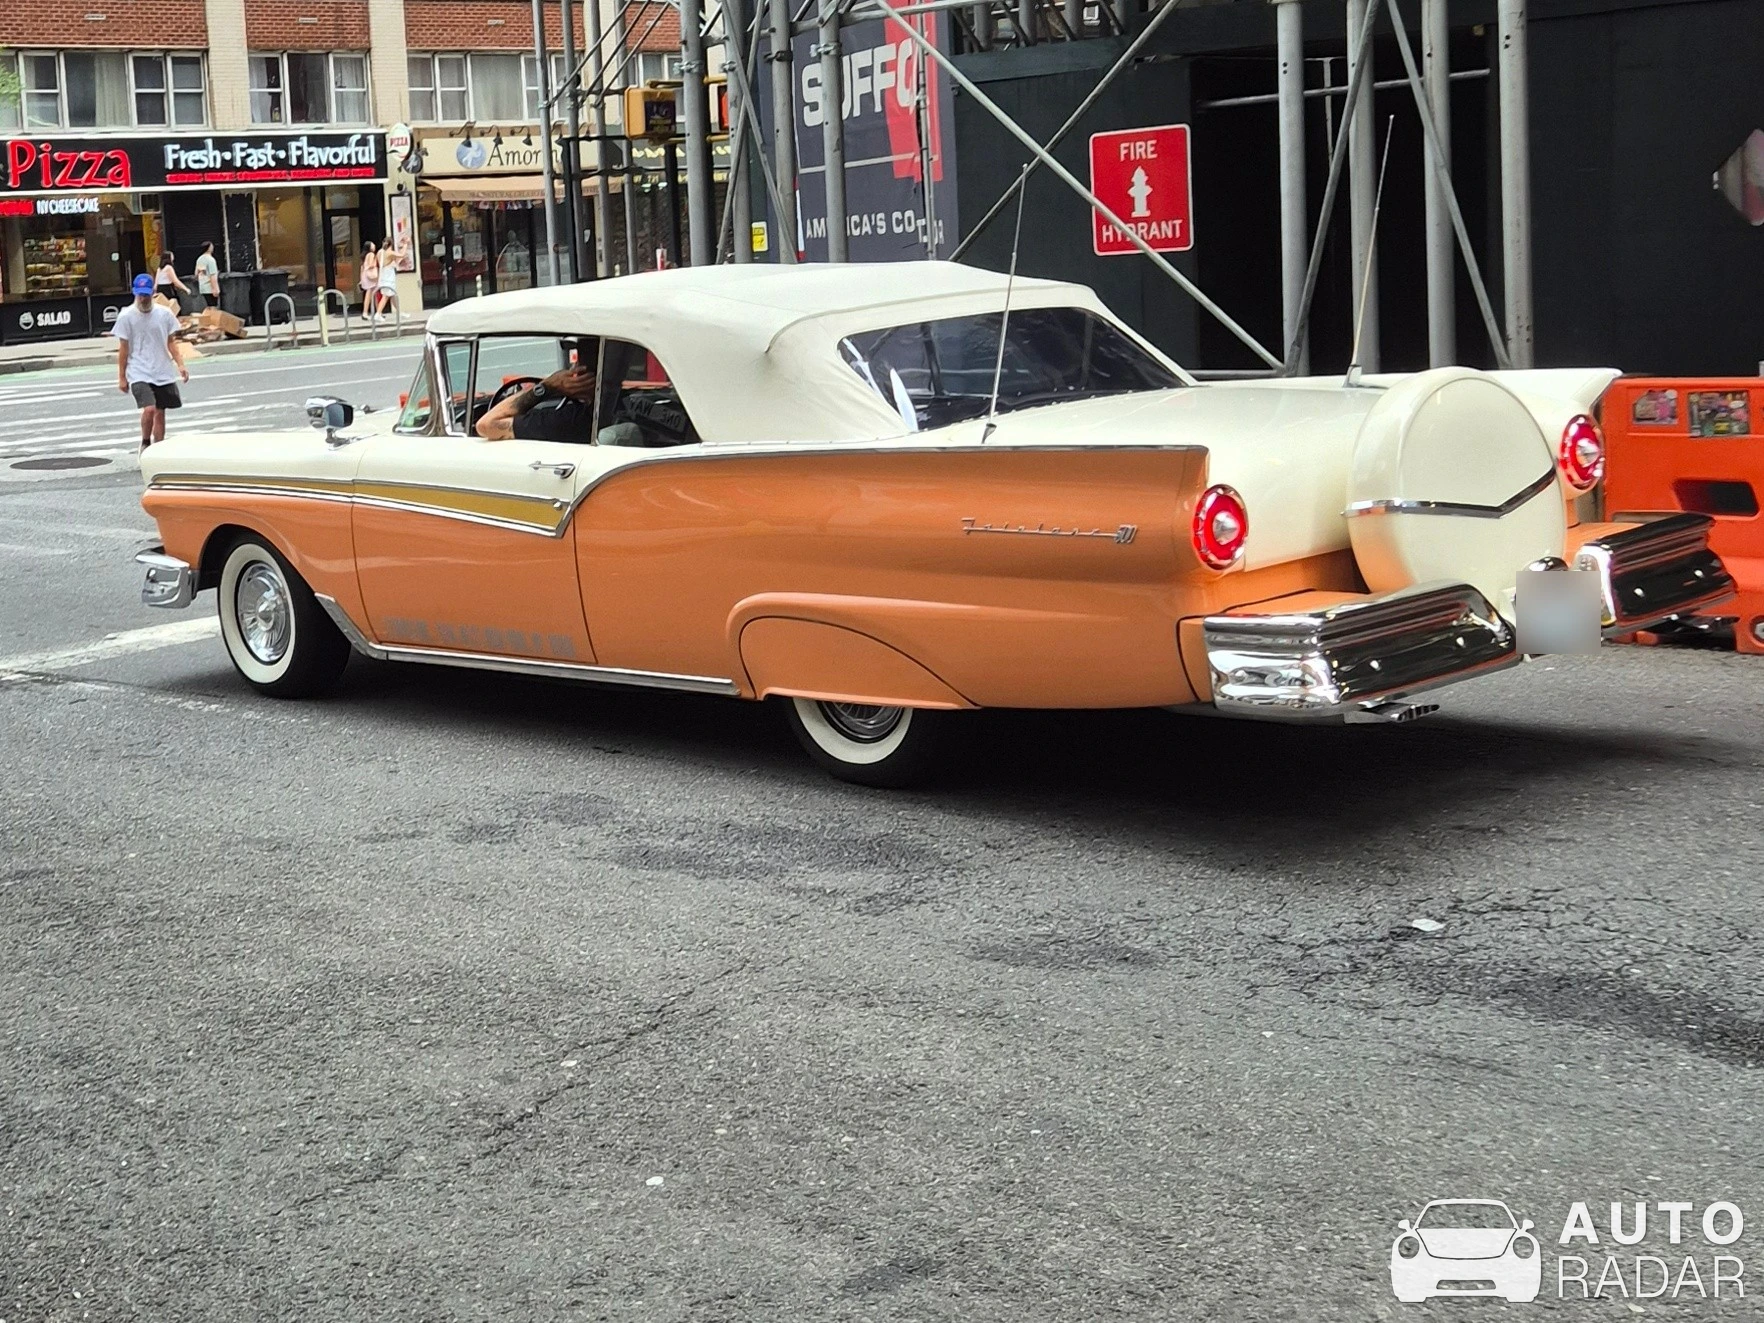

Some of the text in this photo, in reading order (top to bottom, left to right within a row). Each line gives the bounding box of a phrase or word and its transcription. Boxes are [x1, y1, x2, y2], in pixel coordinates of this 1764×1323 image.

[164, 134, 376, 170] Fresh Fast Flavorful
[390, 136, 409, 147] PIZZA
[1120, 139, 1158, 162] FIRE
[7, 139, 132, 188] Pizza
[806, 212, 887, 239] AMICA'S
[37, 310, 71, 327] SALAD
